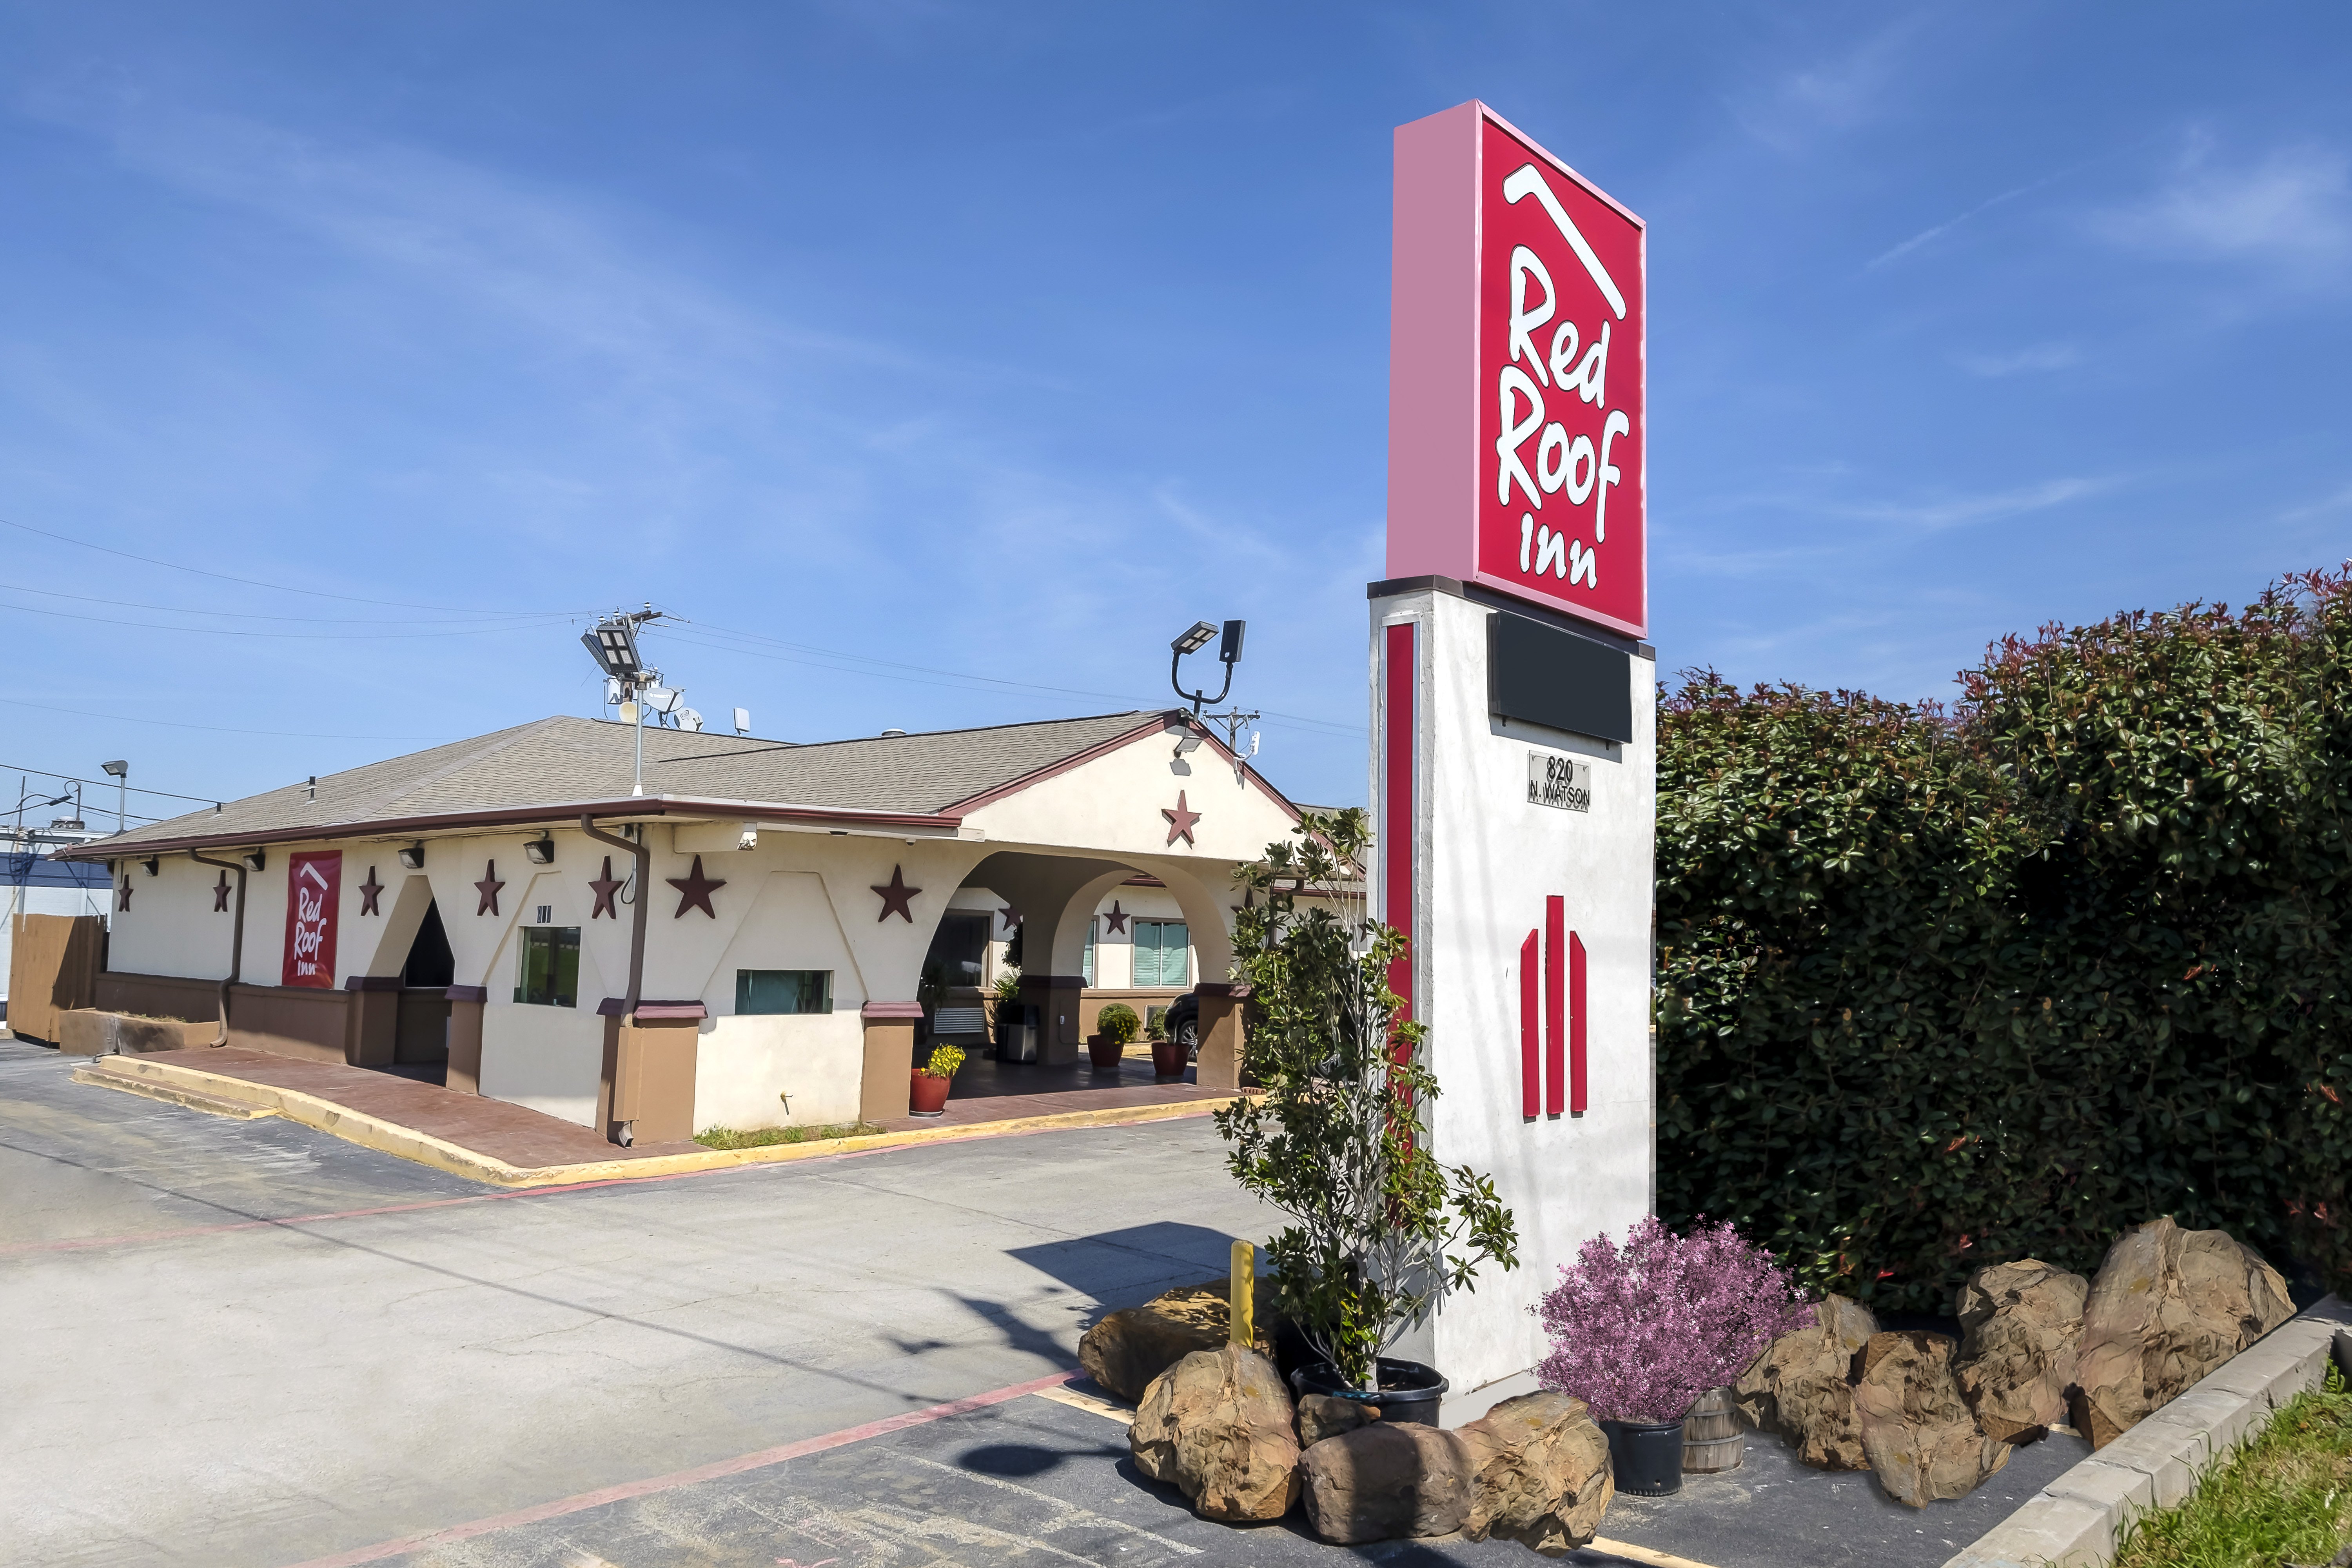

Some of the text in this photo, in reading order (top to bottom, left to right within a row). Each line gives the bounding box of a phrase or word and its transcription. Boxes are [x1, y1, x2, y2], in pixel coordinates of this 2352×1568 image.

[1509, 244, 1611, 409] Red
[1495, 364, 1630, 543] Roof
[1548, 756, 1573, 784] 820
[1530, 780, 1590, 808] N. WATSON
[299, 887, 323, 923] Red
[294, 918, 327, 961] Roof
